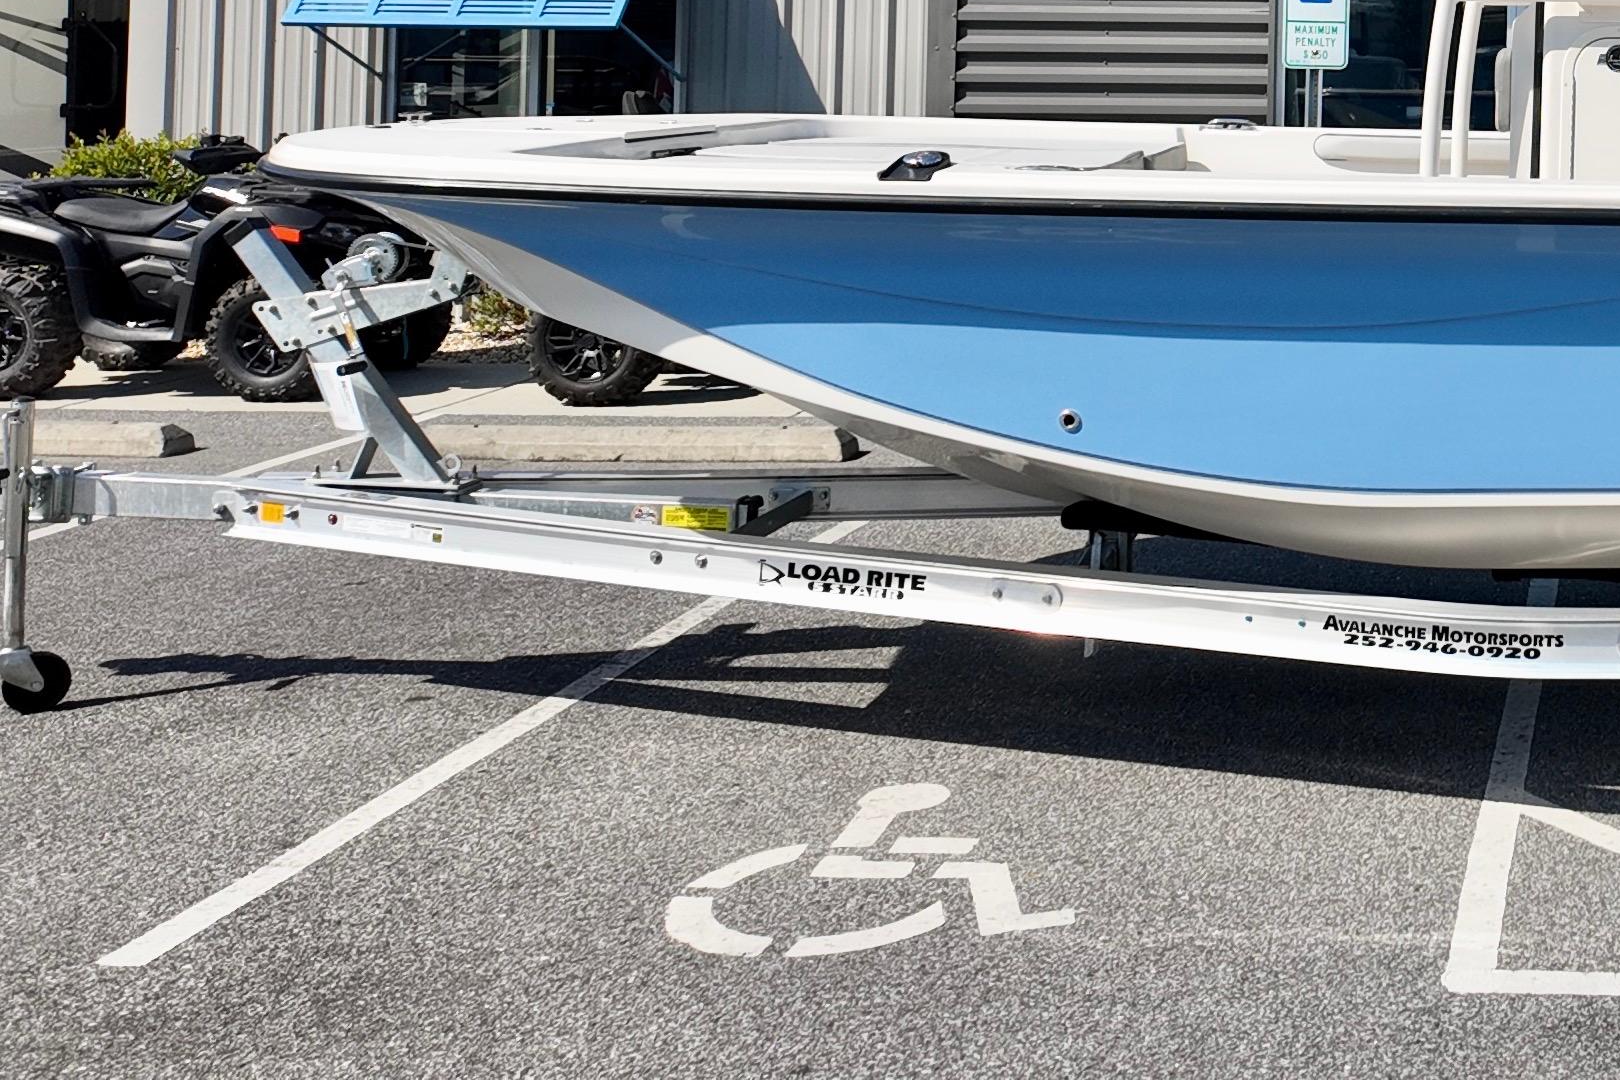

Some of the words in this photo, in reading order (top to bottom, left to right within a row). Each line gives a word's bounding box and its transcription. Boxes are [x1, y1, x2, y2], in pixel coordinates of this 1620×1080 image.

[1294, 25, 1339, 35] MAXIMUM
[1295, 37, 1337, 47] PENALTY
[786, 562, 860, 585] LOAD
[866, 570, 927, 591] RITE
[1322, 614, 1427, 639] AVALANCHE
[1431, 624, 1565, 648] MOTORSPORTS
[1343, 633, 1542, 660] 252-946-0920
